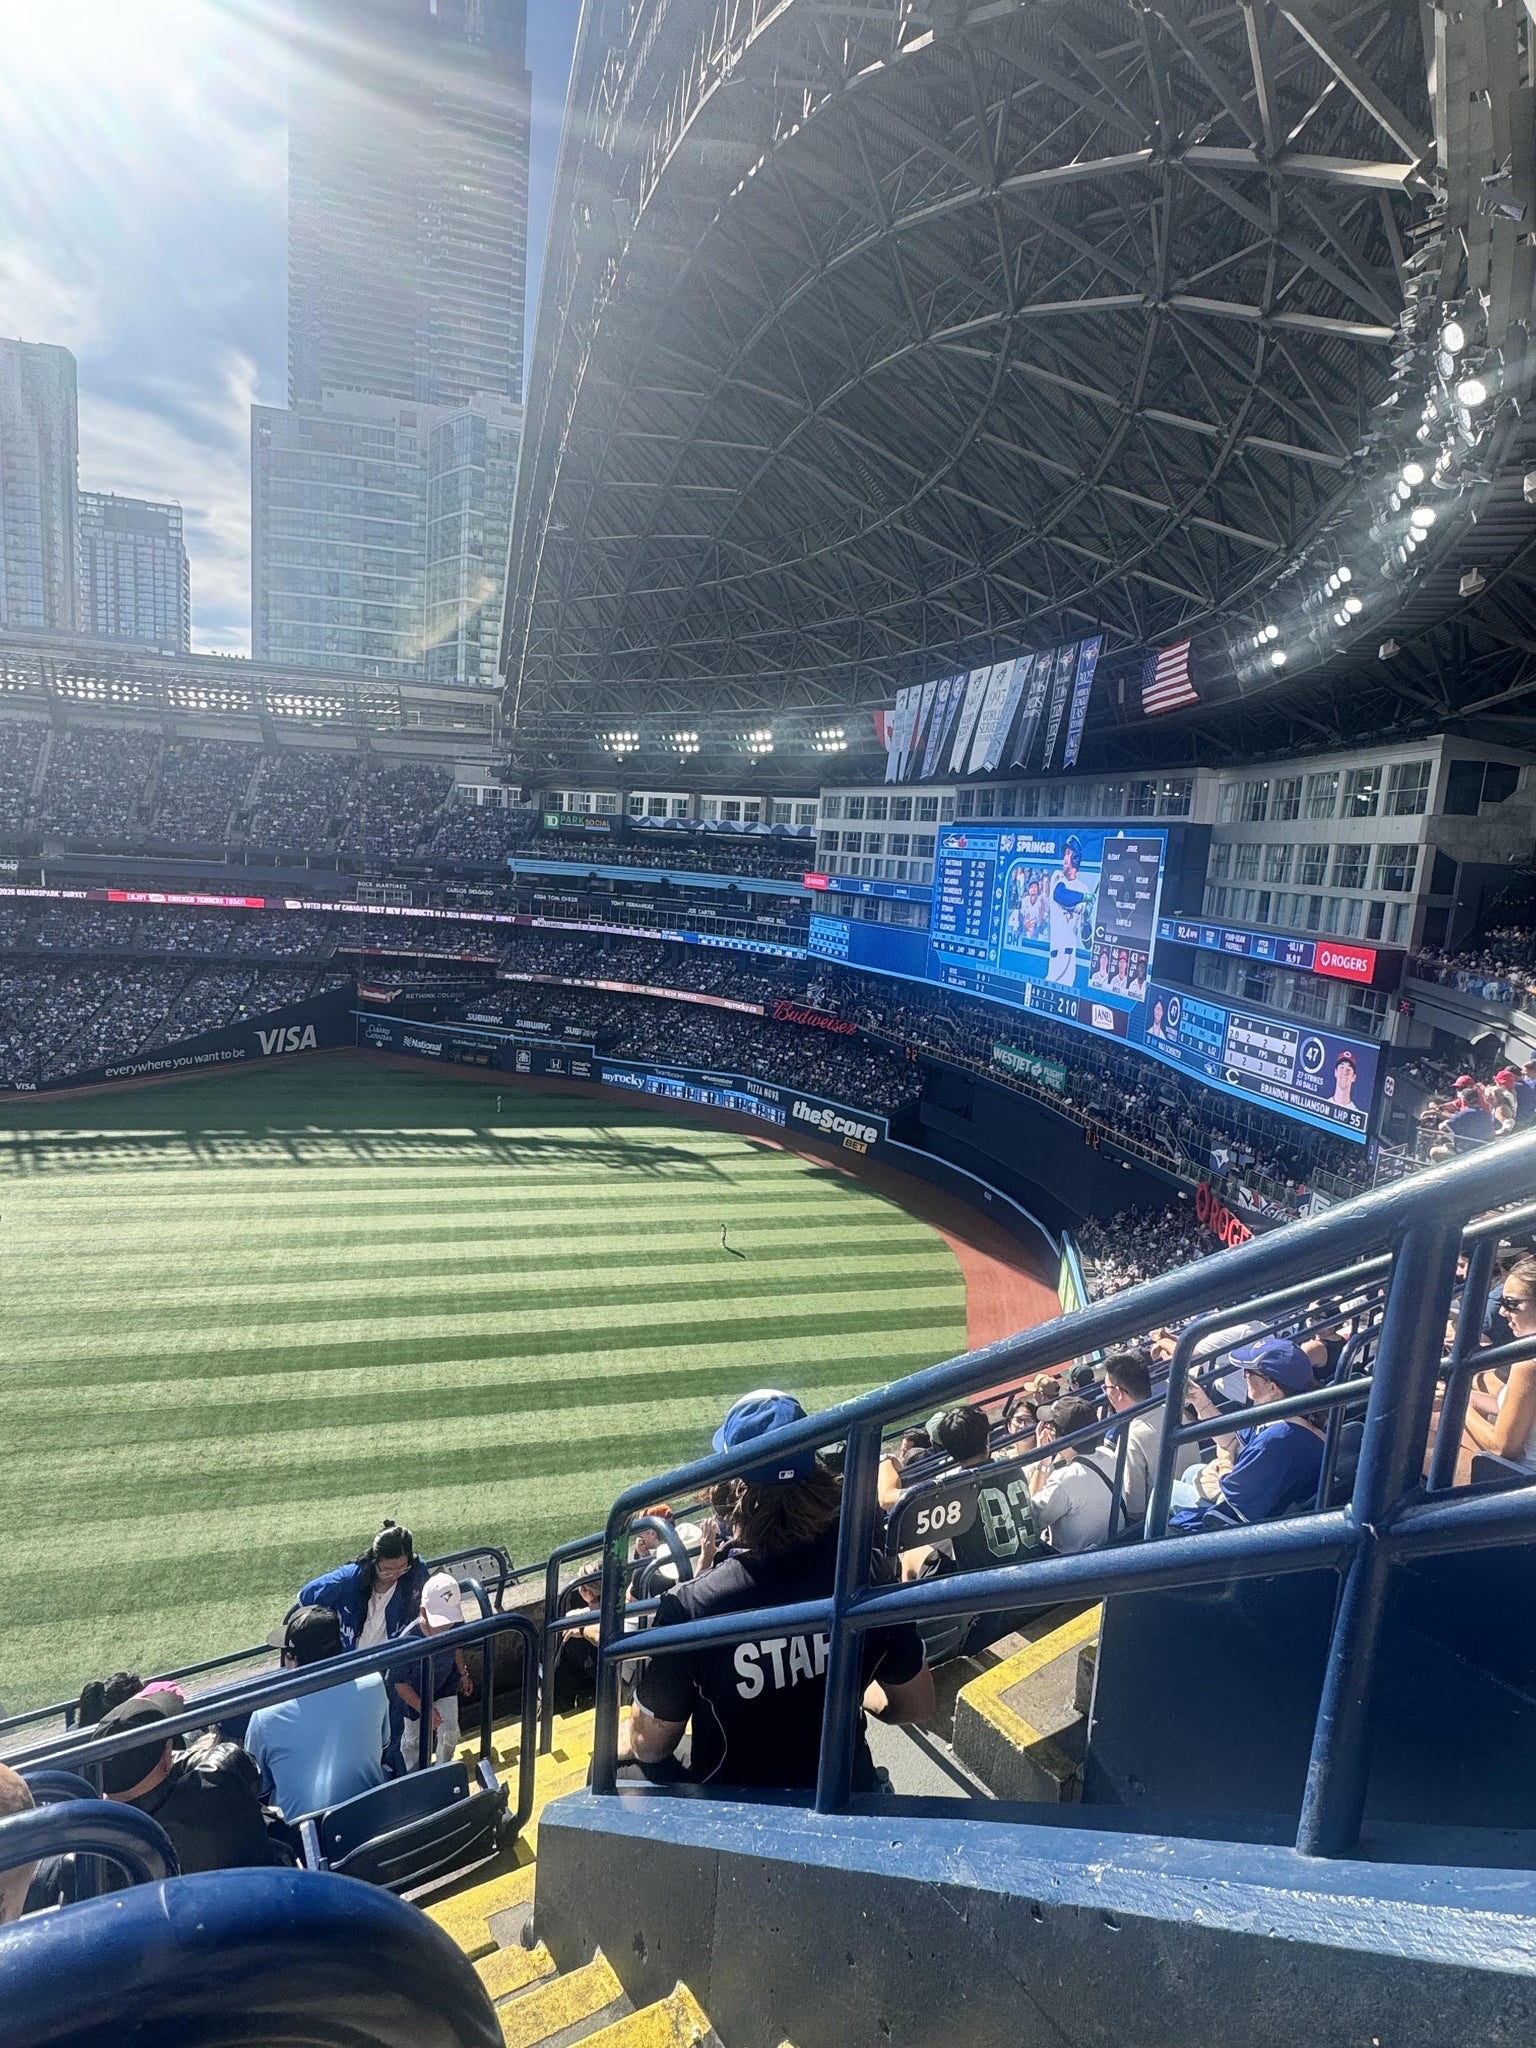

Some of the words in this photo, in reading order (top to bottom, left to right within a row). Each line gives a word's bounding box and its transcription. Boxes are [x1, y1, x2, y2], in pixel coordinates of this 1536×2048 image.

[546, 815, 558, 826] TD
[560, 815, 584, 824] PARK
[1016, 842, 1056, 854] SPRINGER
[468, 888, 494, 896] DELGADO
[402, 908, 434, 917] PRODUCTS
[756, 916, 775, 924] GEORGE
[1008, 909, 1020, 932] 4
[1178, 926, 1190, 939] 92.4
[1094, 944, 1100, 955] 22
[1112, 948, 1119, 959] 46
[1130, 952, 1138, 963] 43
[1331, 954, 1368, 972] ROGERS
[466, 1013, 504, 1024] SUBWAY
[770, 998, 858, 1036] Budweiser
[515, 1020, 551, 1031] SUBWAY
[252, 1024, 318, 1055] VISA
[411, 1038, 442, 1052] National
[1230, 1030, 1240, 1040] 2.0
[1246, 1034, 1251, 1043] 2
[1263, 1038, 1268, 1048] 2
[1282, 1044, 1287, 1054] 2
[993, 1046, 1032, 1074] WESTJET
[1258, 1050, 1268, 1060] FPS
[1278, 1055, 1288, 1066] ERA
[1306, 1046, 1319, 1062] 47
[105, 1060, 172, 1078] everywhere
[173, 1057, 193, 1070] you
[194, 1052, 219, 1064] want
[220, 1050, 232, 1060] to
[232, 1048, 246, 1058] be
[1242, 1056, 1246, 1066] 2
[1259, 1062, 1264, 1072] 3
[1274, 1067, 1288, 1080] 5.05
[602, 1072, 645, 1089] myrocky
[1296, 1070, 1304, 1079] 27
[1304, 1072, 1324, 1086] STRIKES
[1303, 1080, 1318, 1092] BALLS
[746, 1080, 763, 1096] PIZZA
[764, 1090, 780, 1102] NOVA
[1260, 1083, 1289, 1102] BRANDON
[1290, 1089, 1330, 1117] WILLIAMSON
[1333, 1110, 1348, 1122] LHP
[1350, 1115, 1361, 1127] 55
[792, 1100, 878, 1144] theScore
[844, 1140, 866, 1152] BET
[916, 1500, 962, 1534] 508
[976, 1479, 1039, 1558] 83
[734, 1632, 830, 1699] STAF
